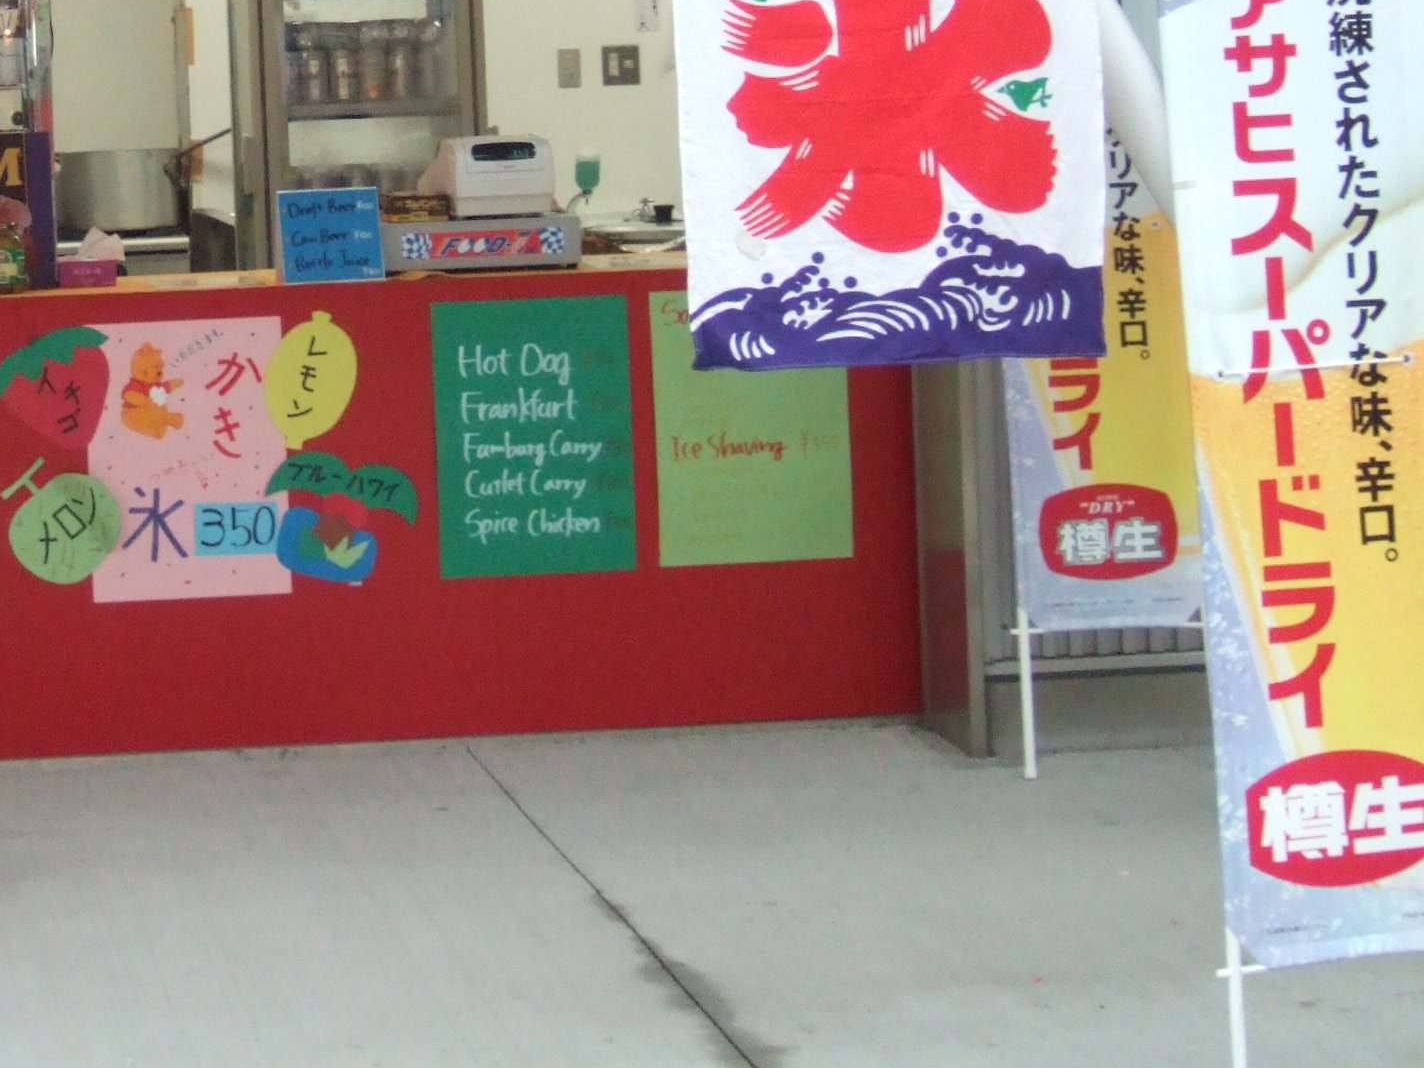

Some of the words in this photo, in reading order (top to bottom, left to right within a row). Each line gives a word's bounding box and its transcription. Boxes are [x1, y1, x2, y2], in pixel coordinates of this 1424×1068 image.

[286, 335, 328, 420] レモン
[457, 345, 510, 379] Hot
[520, 342, 573, 387] Dog
[204, 351, 263, 459] かき
[460, 387, 579, 423] Frankfurt
[670, 435, 703, 463] Ice
[287, 462, 404, 504] ブルーハワイ
[38, 486, 97, 566] メロン
[122, 486, 189, 563] 氷
[199, 505, 278, 548] 350
[464, 509, 519, 545] Spice
[527, 507, 602, 538] Chicken
[1057, 517, 1166, 566] 樽生
